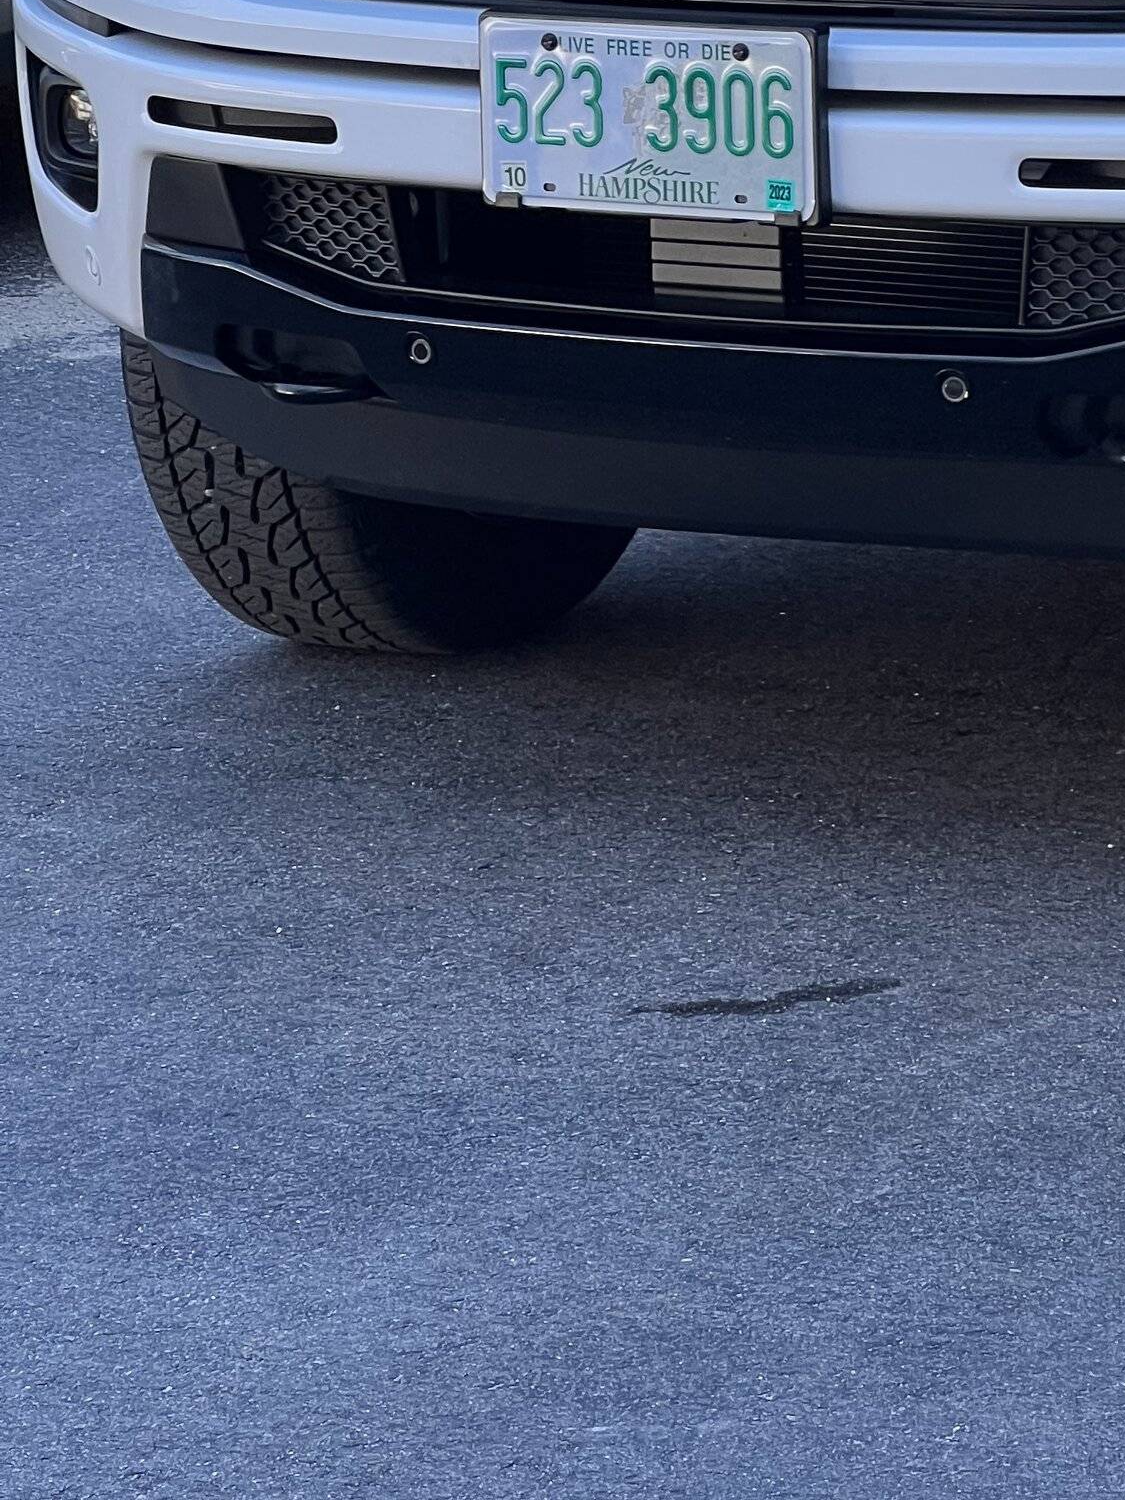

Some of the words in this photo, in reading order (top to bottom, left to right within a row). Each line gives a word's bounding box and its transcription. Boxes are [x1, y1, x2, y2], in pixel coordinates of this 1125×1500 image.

[607, 39, 652, 57] FREE
[664, 41, 689, 59] OR
[702, 43, 731, 61] DIE
[495, 57, 604, 148] 523
[645, 65, 795, 159] 3906
[504, 166, 526, 187] 10
[603, 157, 691, 176] New
[578, 172, 721, 205] HAMPSHIRE
[769, 184, 791, 201] 2023
